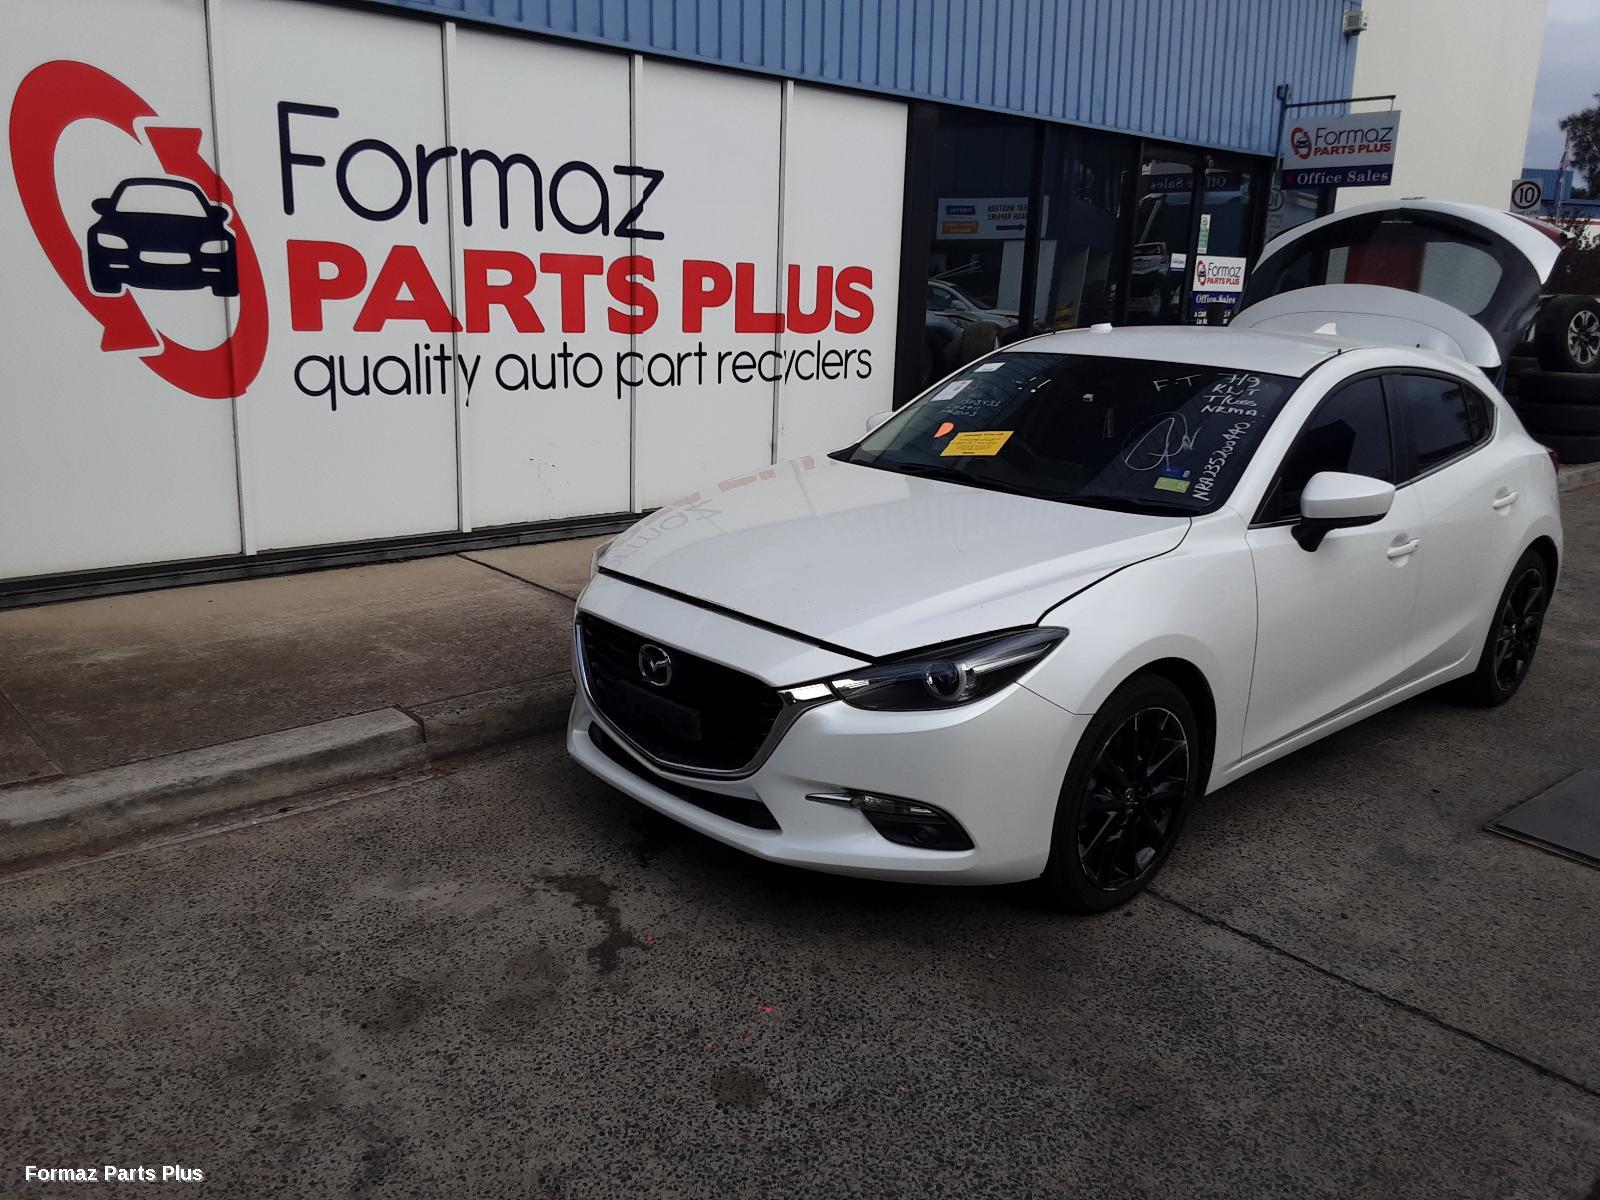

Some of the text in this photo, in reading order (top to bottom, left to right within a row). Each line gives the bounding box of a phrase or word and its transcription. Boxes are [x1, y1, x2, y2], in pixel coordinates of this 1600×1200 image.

[1314, 127, 1394, 146] Formaz
[1313, 143, 1392, 156] PARTS PLUS
[277, 100, 665, 241] Formaz
[1297, 170, 1389, 185] Office Sales
[1519, 186, 1535, 204] 10
[1207, 262, 1242, 278] Formaz
[286, 239, 875, 335] PARTS PLUS
[1206, 277, 1240, 286] PARTS PLUS
[294, 340, 873, 412] quality auto part recyclers
